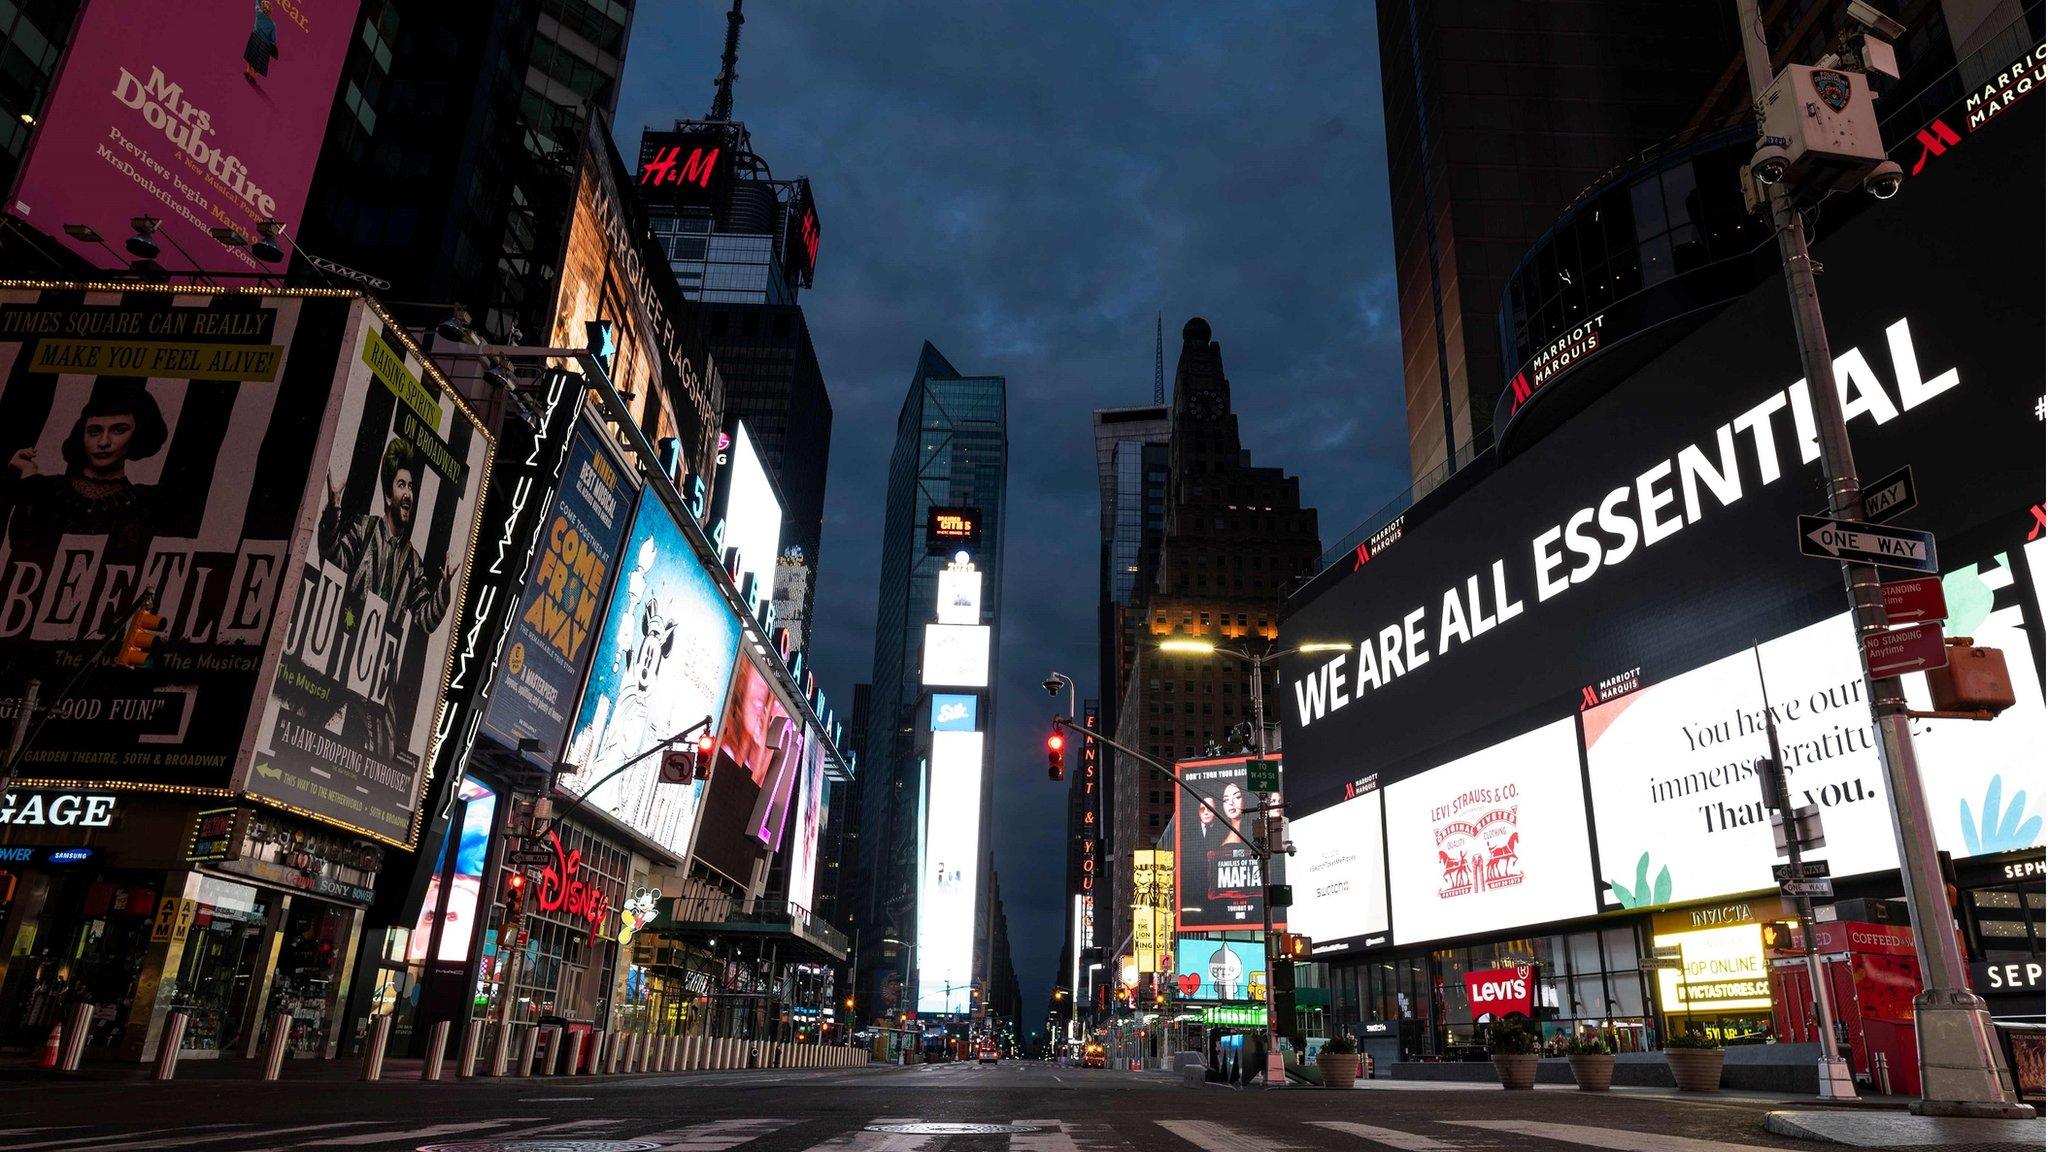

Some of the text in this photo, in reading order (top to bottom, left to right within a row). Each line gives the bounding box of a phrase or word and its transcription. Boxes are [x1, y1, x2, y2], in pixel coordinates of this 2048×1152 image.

[143, 65, 215, 136] Mrs.
[112, 66, 277, 219] Doubtfire
[173, 149, 183, 161] A
[184, 158, 204, 177] New
[640, 145, 721, 190] H&M
[108, 126, 172, 181] Previews
[175, 174, 209, 210] begin
[210, 203, 249, 238] March
[591, 179, 664, 335] MARQUEE
[312, 256, 386, 290] LAMAR
[3, 310, 269, 337] TIMES SQUARE CAN REALLY
[39, 343, 276, 373] MAKE YOU FEEL ALIVE!
[1533, 315, 1604, 371] MARRIOTT
[1535, 336, 1597, 386] MARQUIS
[371, 340, 436, 426] RAISING SPIRITS
[403, 413, 462, 485] ON BROADWAY!
[1866, 485, 1900, 514] WAY
[560, 500, 577, 525] COME
[576, 519, 603, 555] TOGETHER
[1293, 316, 1961, 728] WE ARE ALL ESSENTIAL
[1371, 515, 1405, 546] MARRIOTT
[550, 515, 606, 597] COME
[1371, 529, 1402, 556] MARQUIS
[1820, 529, 1918, 557] ONE WAY
[0, 549, 277, 641] BEETLE
[283, 574, 398, 707] JUICE
[523, 589, 588, 664] AWAY
[1866, 629, 1922, 649] NO STANDING
[163, 652, 261, 671] The Musical.
[1869, 644, 1905, 659] Anytime
[278, 662, 331, 702] The Musical.
[1600, 667, 1641, 689] MARRIOTT
[1601, 679, 1638, 700] MARQUIS
[1682, 678, 1863, 751] You have our
[24, 750, 71, 764] GARDEN
[153, 752, 162, 766] &
[164, 752, 228, 768] BROADWAY
[290, 726, 362, 775] JAW-DROPPING
[1258, 763, 1267, 771] TO
[1258, 771, 1267, 779] 45
[1084, 810, 1095, 825] &
[1431, 783, 1519, 822] LEVI STRAUSS & CO.
[1698, 777, 1876, 834] Than you.
[54, 852, 87, 860] SAMSUNG
[1802, 864, 1822, 875] WAY
[321, 880, 351, 898] SONY
[1217, 866, 1262, 889] MAFIA
[1787, 882, 1825, 891] ONE WAY
[156, 899, 175, 937] ATM
[177, 901, 191, 938] ATM
[1691, 904, 1754, 927] INVICTA
[1135, 930, 1151, 940] LION
[1852, 931, 1901, 947] COFFEED
[1709, 956, 1758, 975] ONLINE
[1987, 963, 2043, 989] SEP
